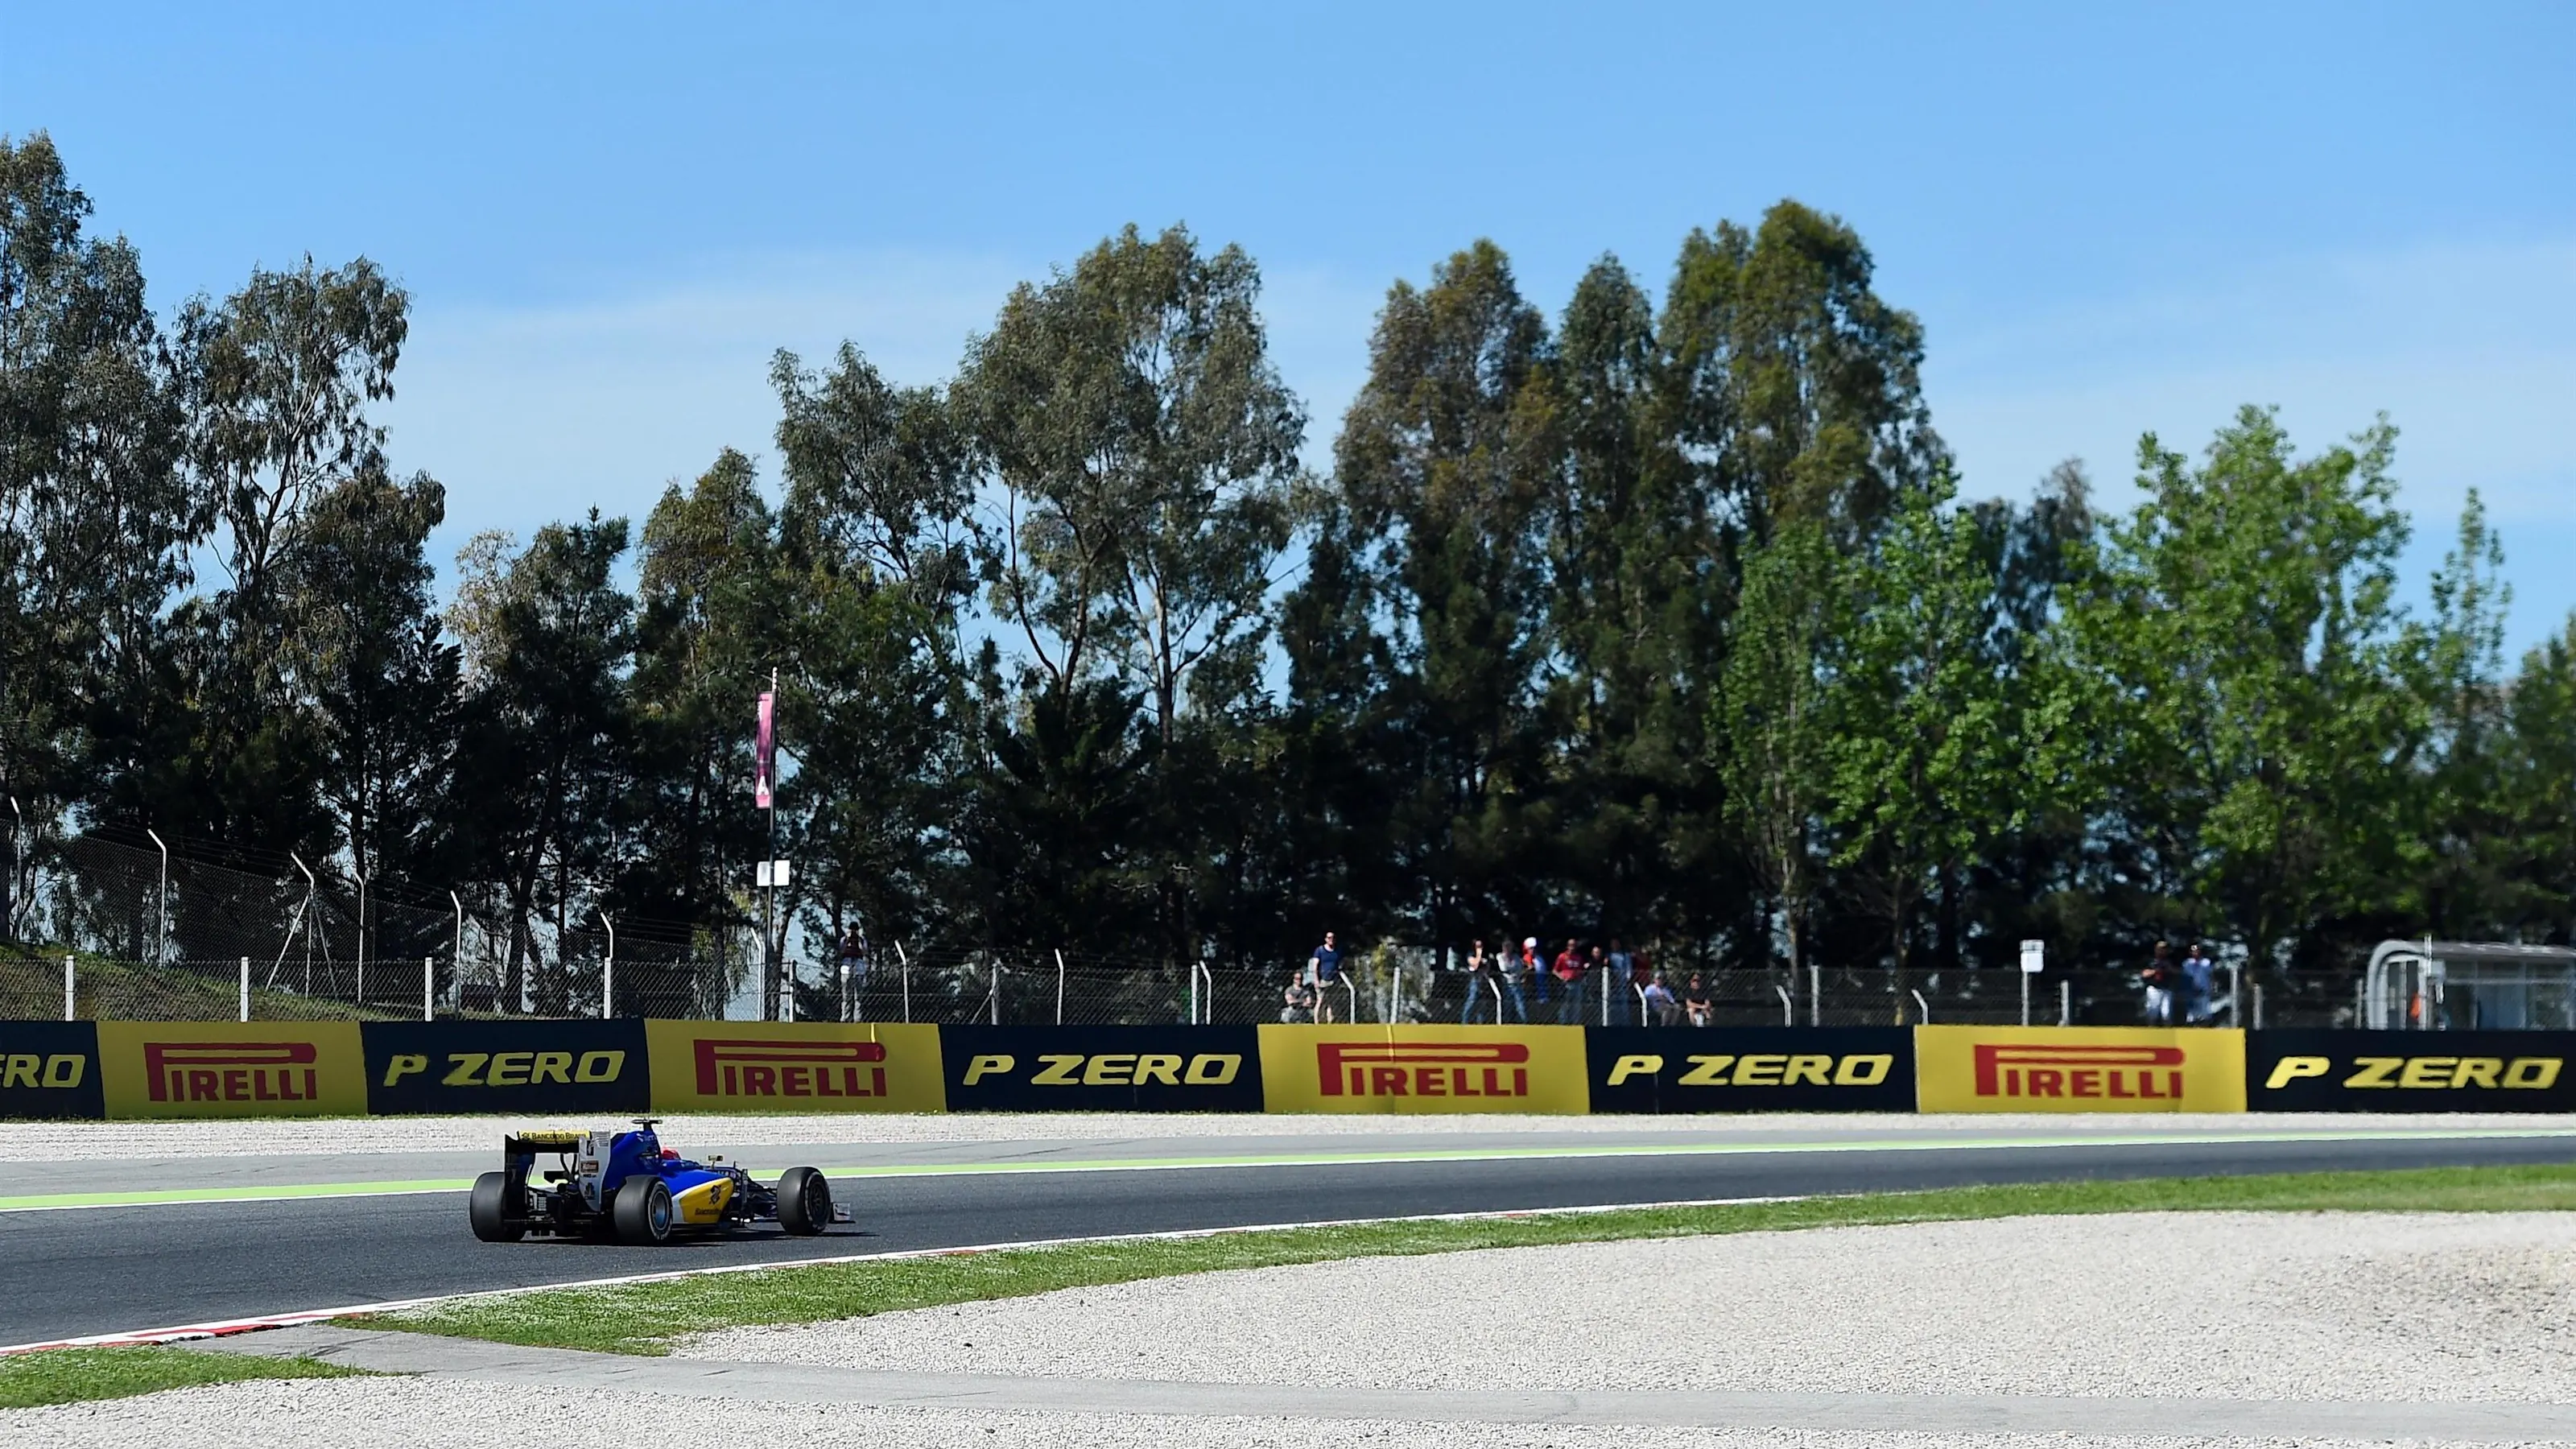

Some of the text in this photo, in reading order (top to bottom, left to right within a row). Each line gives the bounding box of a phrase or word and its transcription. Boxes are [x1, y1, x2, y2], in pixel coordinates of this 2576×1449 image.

[143, 1042, 317, 1102] PIRELLI
[383, 1051, 626, 1087] P ZERO
[693, 1039, 886, 1096] PIRELLI
[963, 1054, 1242, 1085] P ZERO
[1316, 1043, 1530, 1096] PIRELLI
[1608, 1054, 1893, 1086] P ZERO
[1972, 1044, 2186, 1099] PIRELLI
[2265, 1056, 2564, 1090] P ZERO
